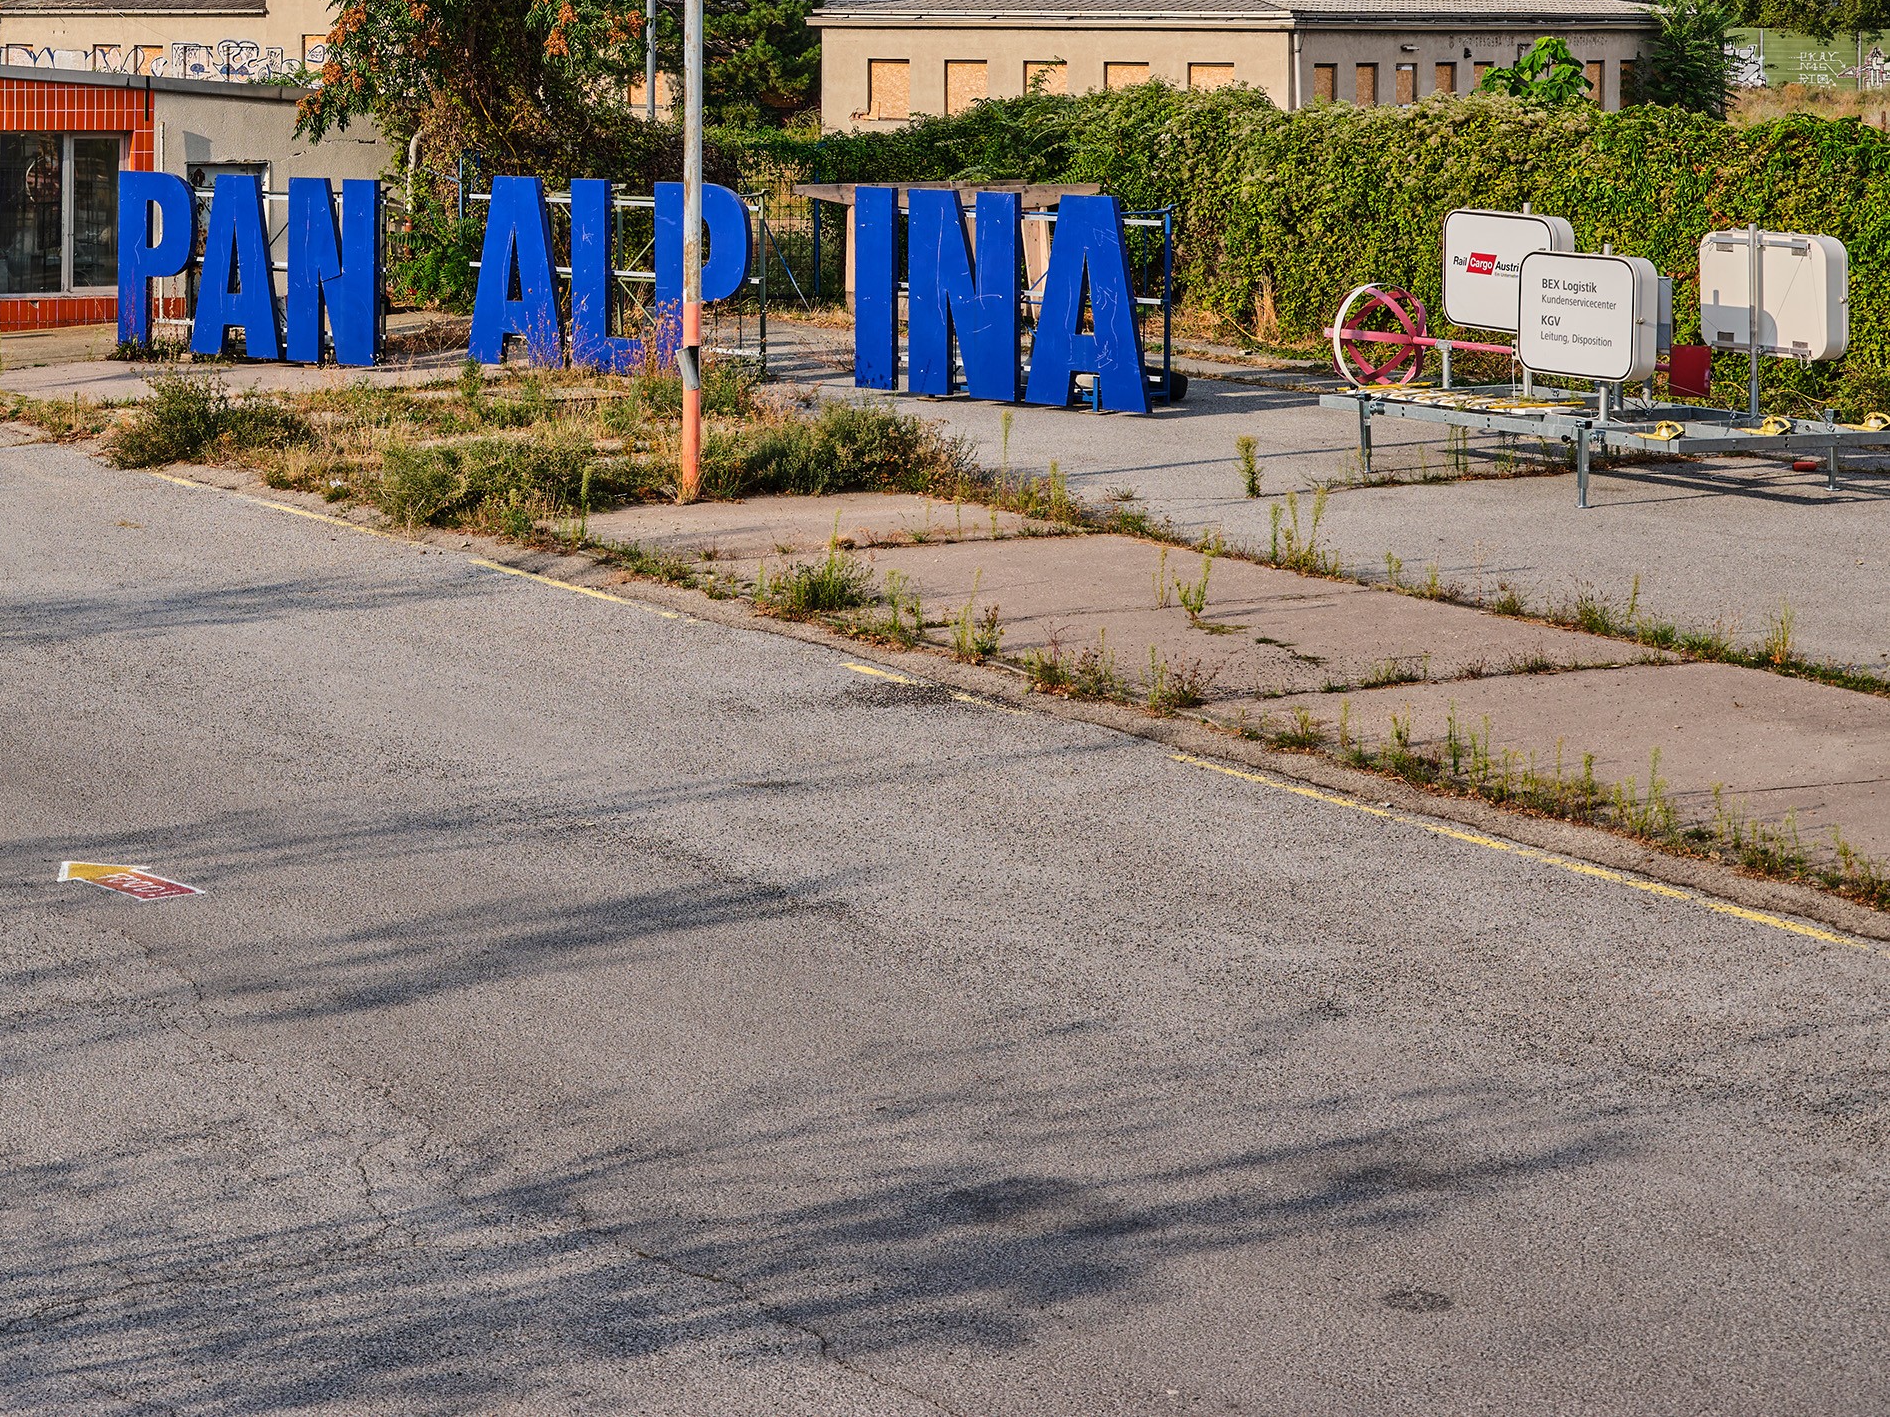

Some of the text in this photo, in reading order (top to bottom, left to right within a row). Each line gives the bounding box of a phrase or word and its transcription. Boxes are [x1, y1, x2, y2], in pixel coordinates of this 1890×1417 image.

[117, 169, 381, 367] PAN
[1452, 255, 1519, 273] Rail Cargo Austri
[1542, 278, 1598, 294] BEX Logistik
[1541, 294, 1617, 311] Kundenservicecenter
[1541, 315, 1561, 327] KGV
[1540, 331, 1613, 347] Leitung, Disposition
